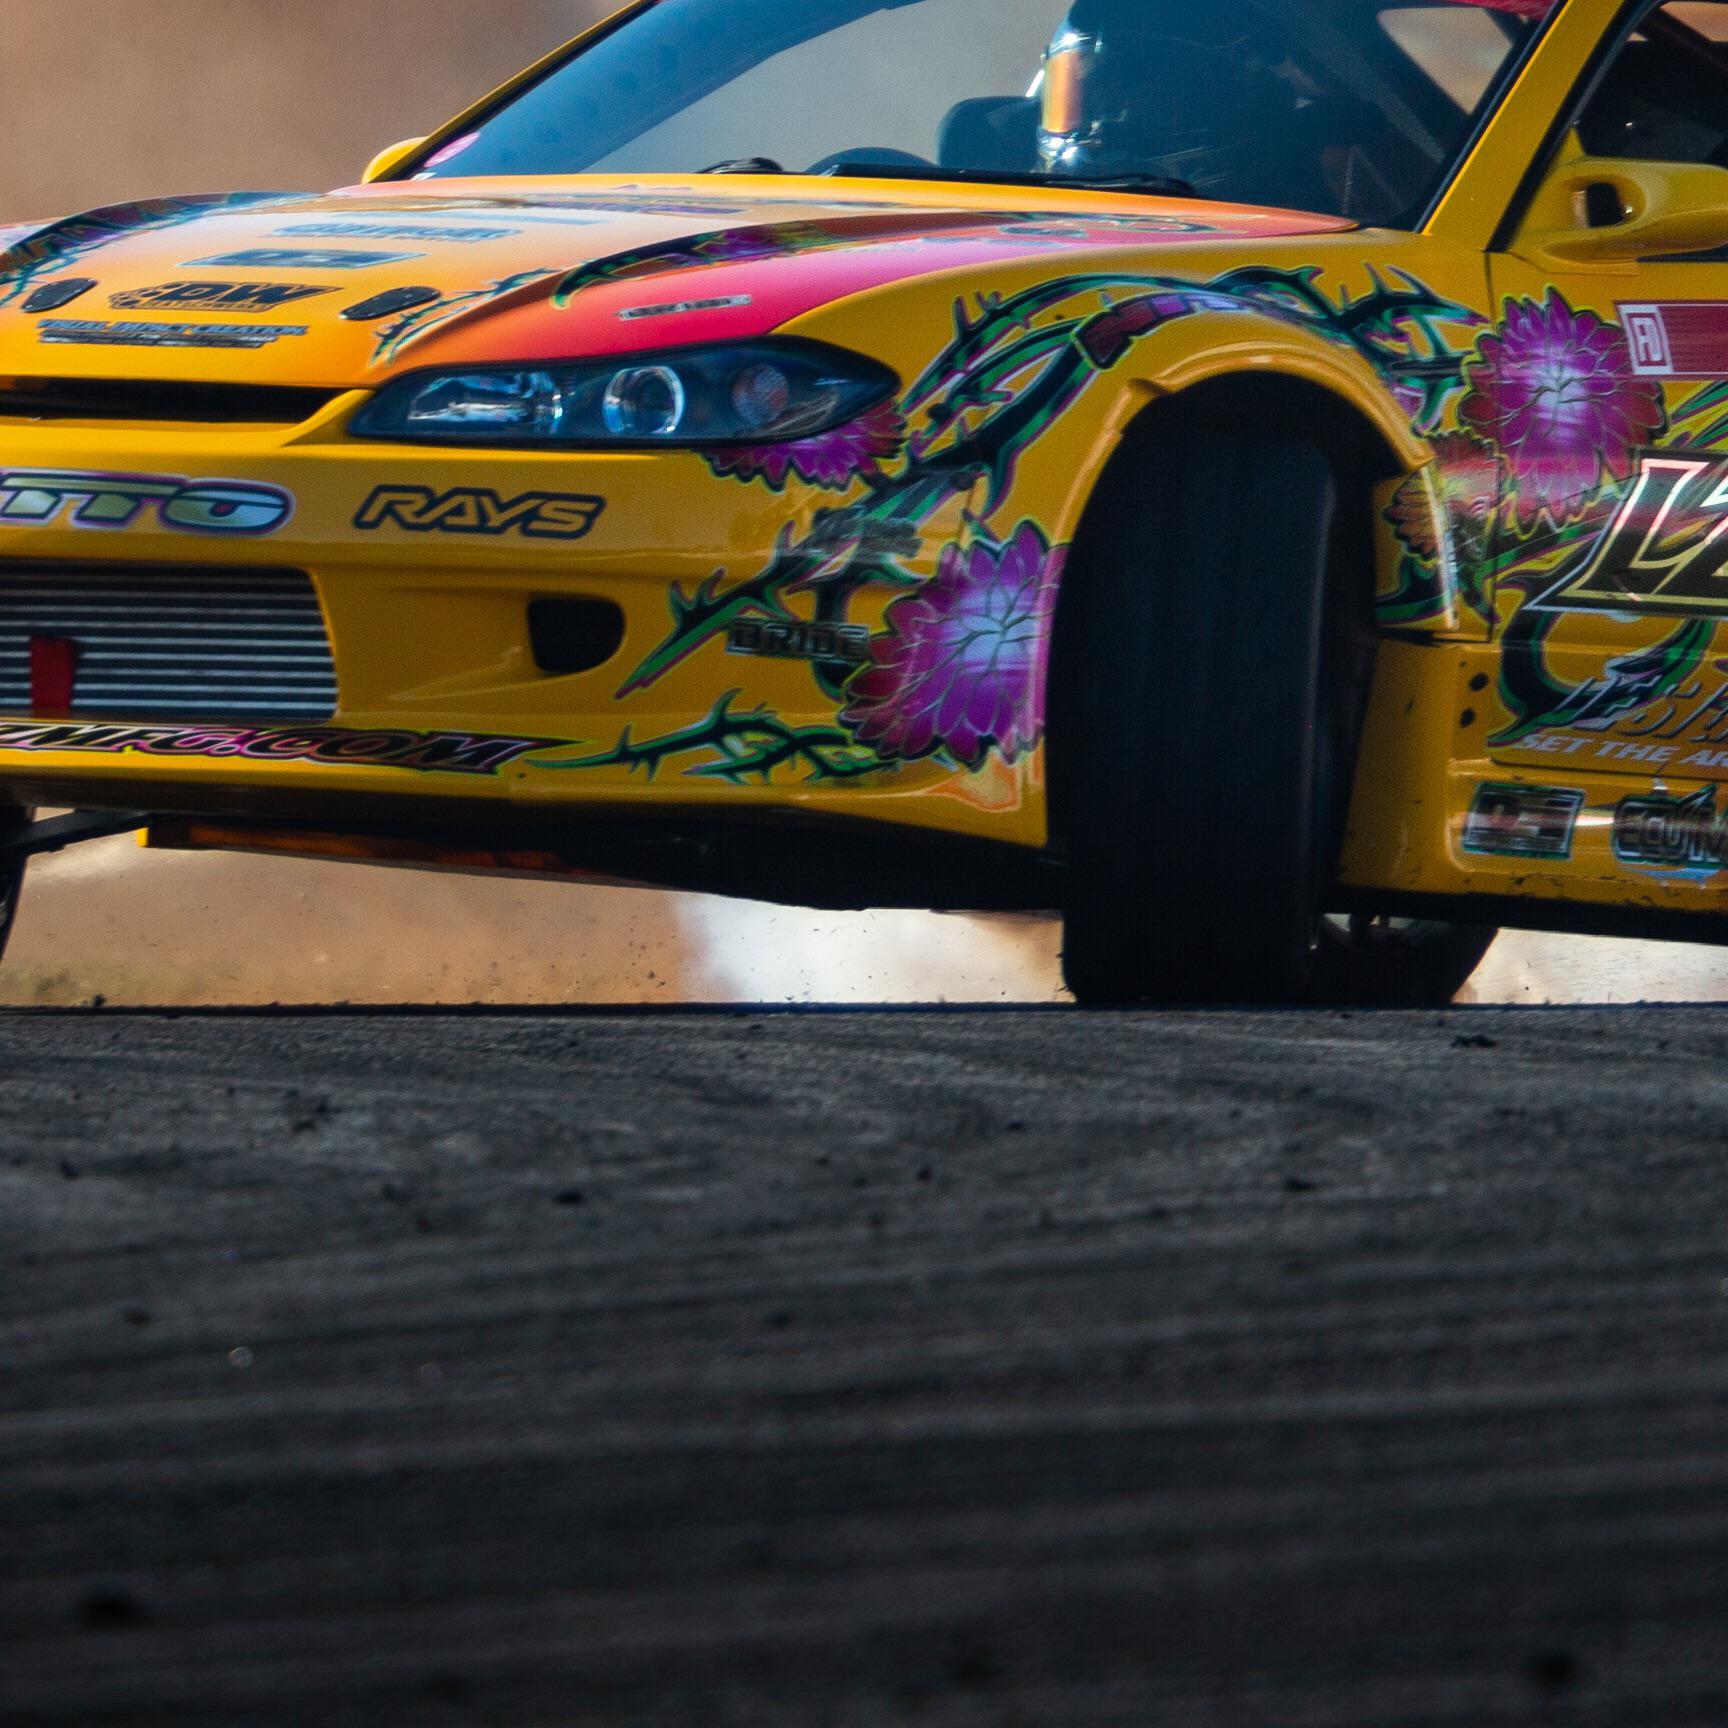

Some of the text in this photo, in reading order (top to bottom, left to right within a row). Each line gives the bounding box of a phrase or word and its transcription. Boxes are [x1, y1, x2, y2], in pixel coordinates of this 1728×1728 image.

[352, 484, 607, 539] RAYS
[728, 619, 868, 663] BRIDE
[1514, 733, 1594, 756] SET
[1594, 740, 1680, 763] THE
